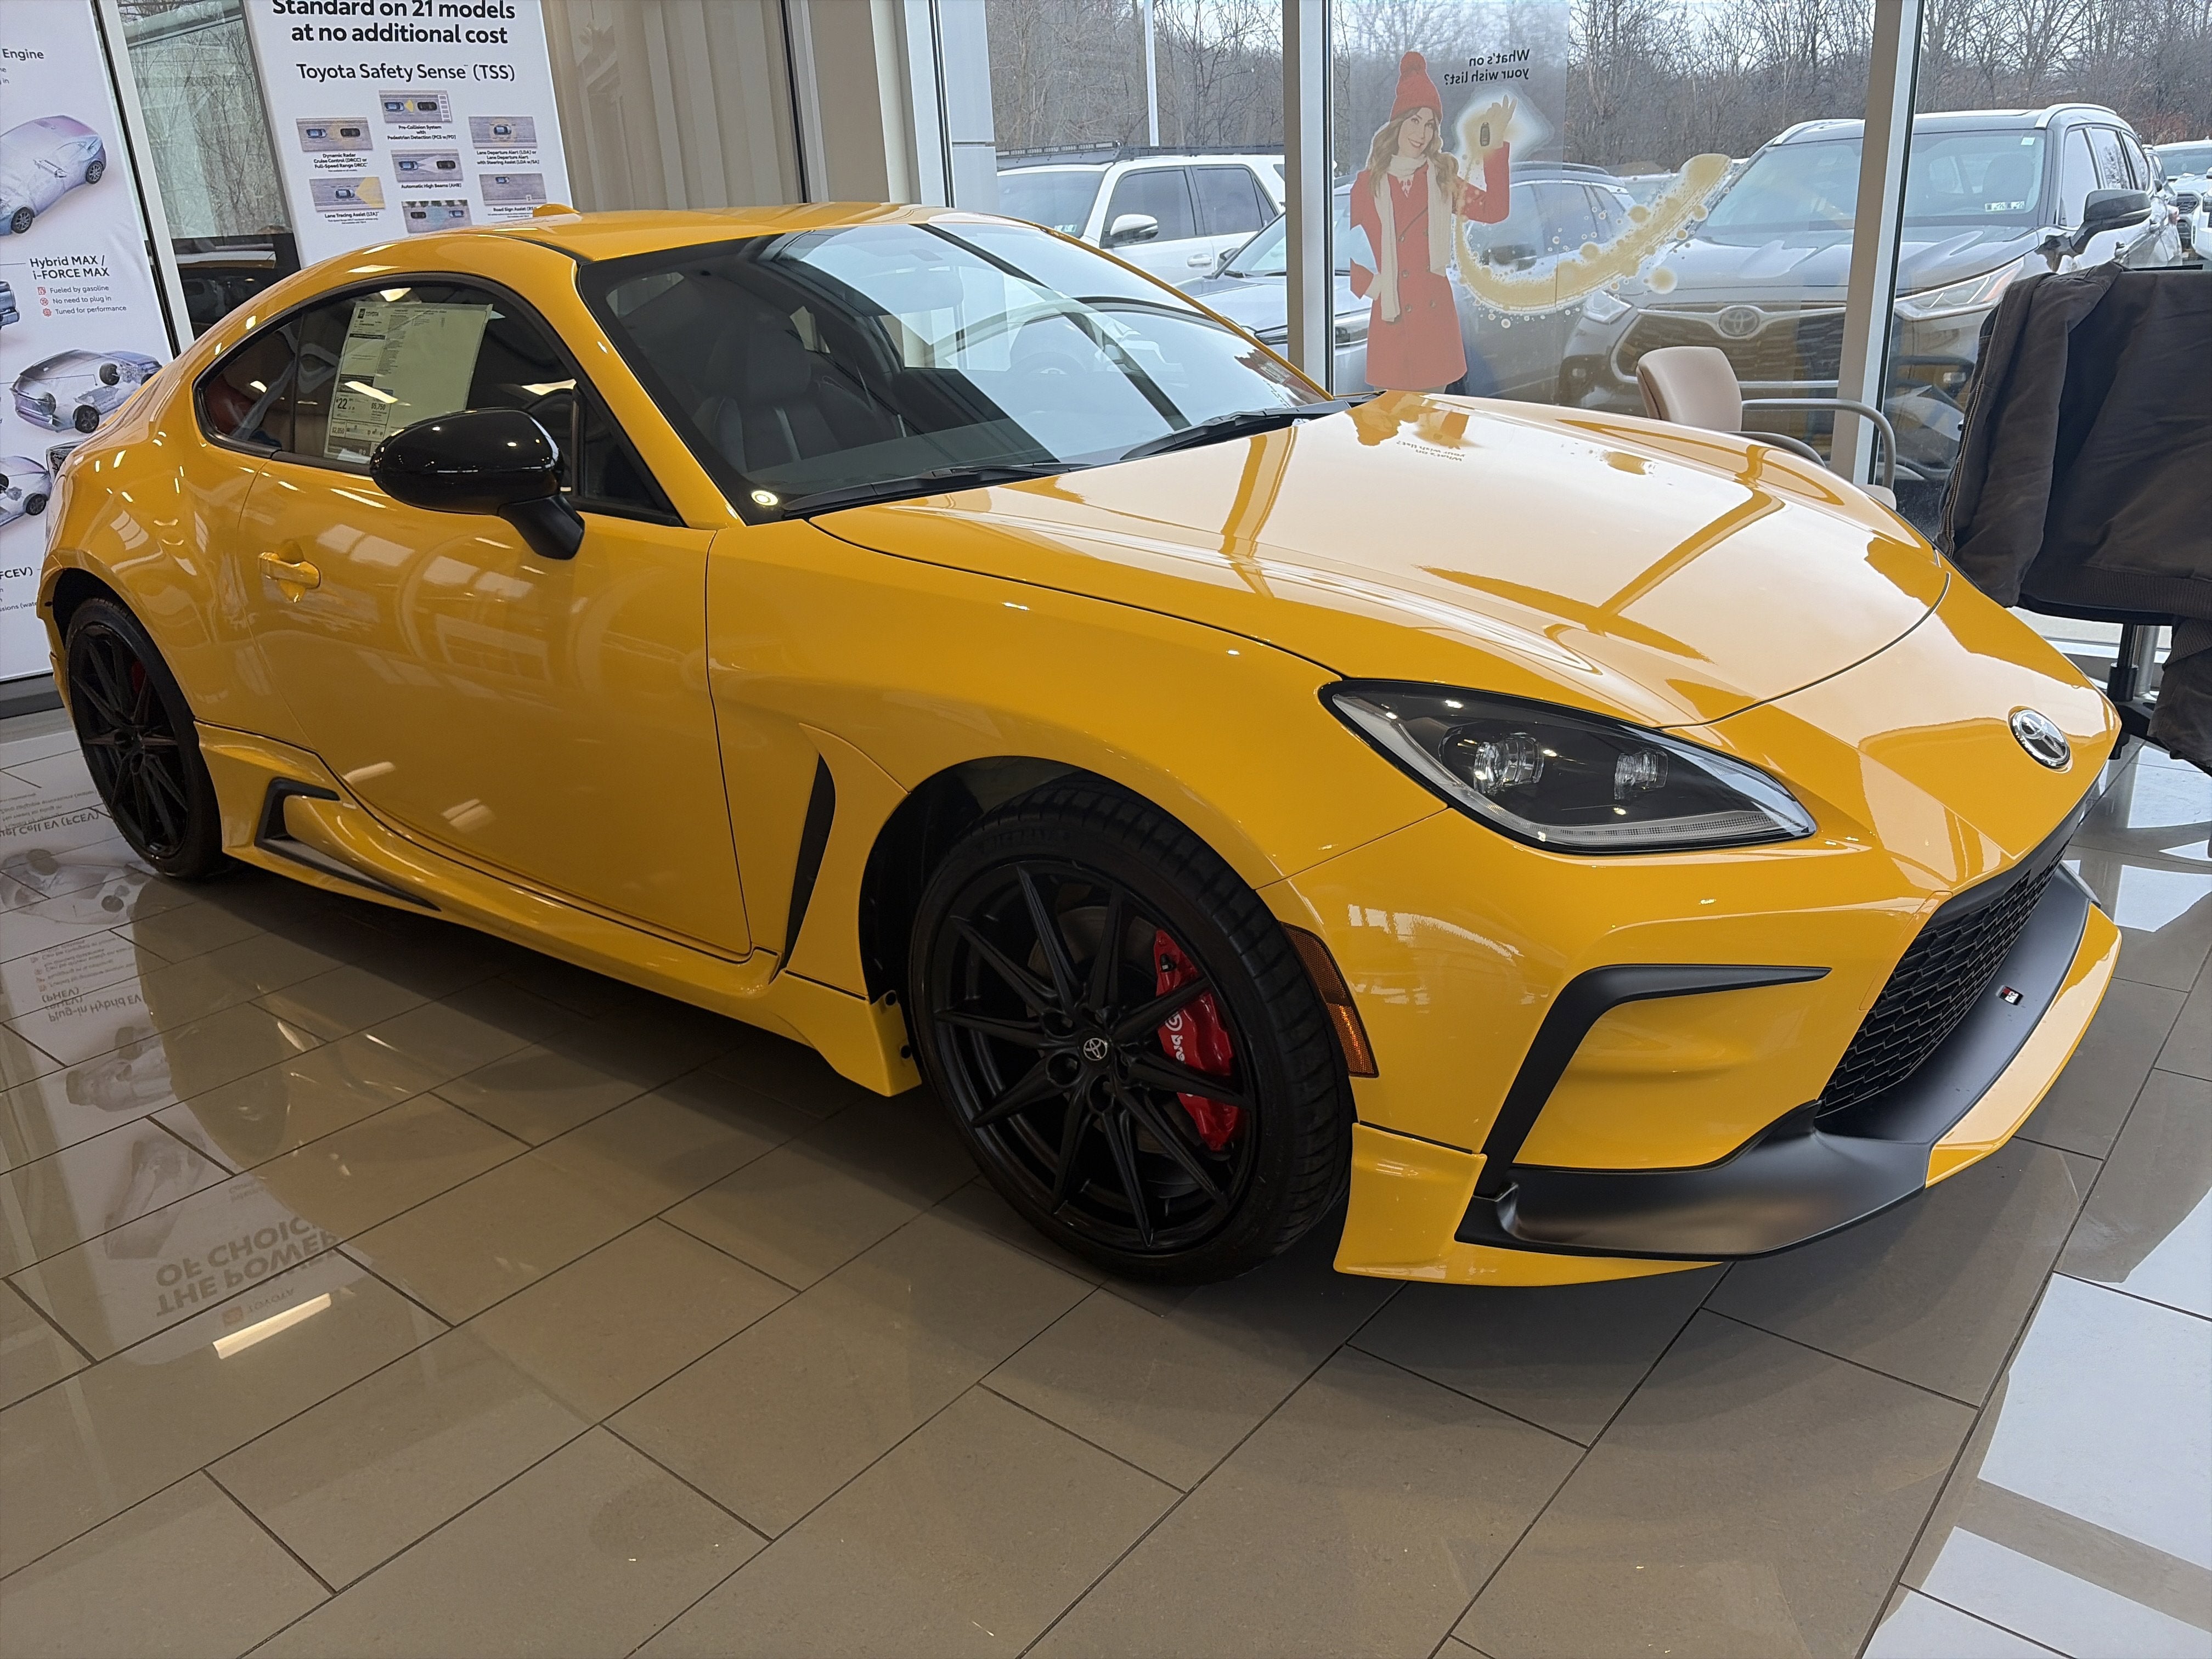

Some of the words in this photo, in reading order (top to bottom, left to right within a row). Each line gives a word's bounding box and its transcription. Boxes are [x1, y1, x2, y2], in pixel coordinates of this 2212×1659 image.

[273, 0, 374, 15] Standard
[380, 1, 408, 16] on
[413, 0, 433, 17] 21
[439, 0, 516, 19] models
[291, 23, 314, 41] at
[318, 26, 347, 42] no
[352, 22, 461, 43] additional
[465, 26, 509, 44] cost
[2, 48, 44, 61] Engine
[296, 63, 357, 82] Toyota
[359, 63, 414, 82] Safety
[473, 64, 515, 82] (TSS)
[30, 256, 69, 269] Hybrid
[71, 255, 99, 266] MAX
[101, 255, 105, 266] /
[32, 268, 81, 280] i-FORCE
[83, 267, 110, 277] MAX
[87, 306, 127, 314] performance
